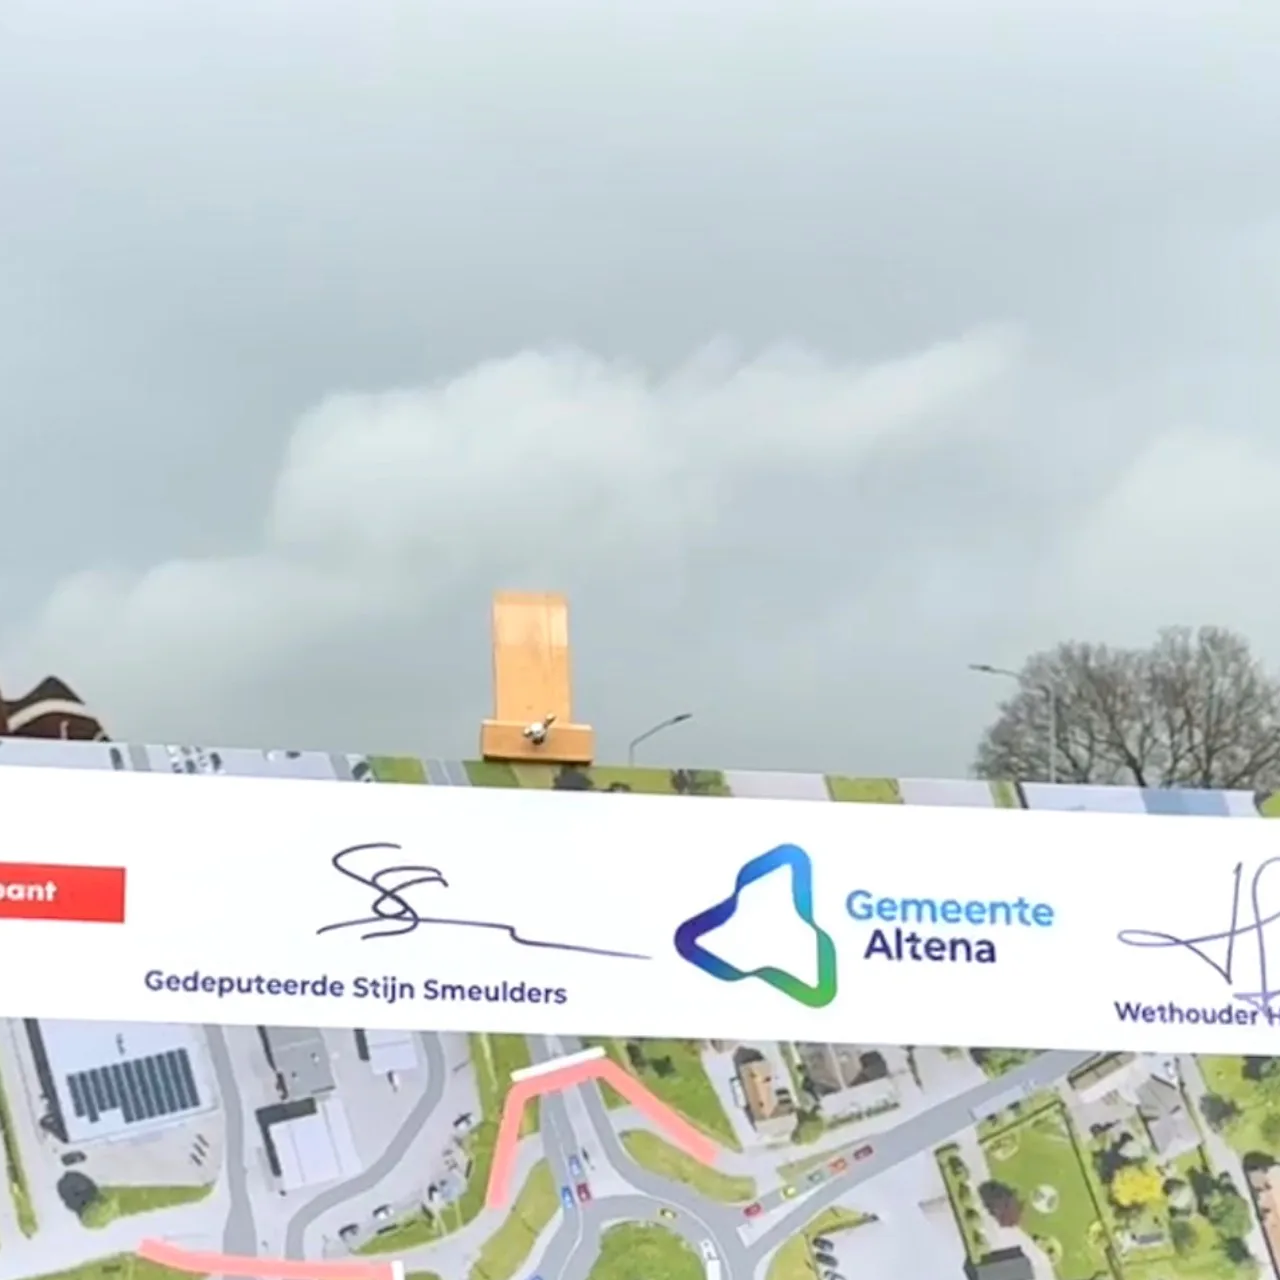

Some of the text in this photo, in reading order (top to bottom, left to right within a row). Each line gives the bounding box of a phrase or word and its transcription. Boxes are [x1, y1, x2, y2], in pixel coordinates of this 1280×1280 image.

[846, 889, 1055, 928] Gemeente
[864, 927, 998, 965] Altena
[144, 970, 568, 1005] Gedeputeerde Stijn Smeulders
[1114, 1001, 1259, 1027] Wethouder
